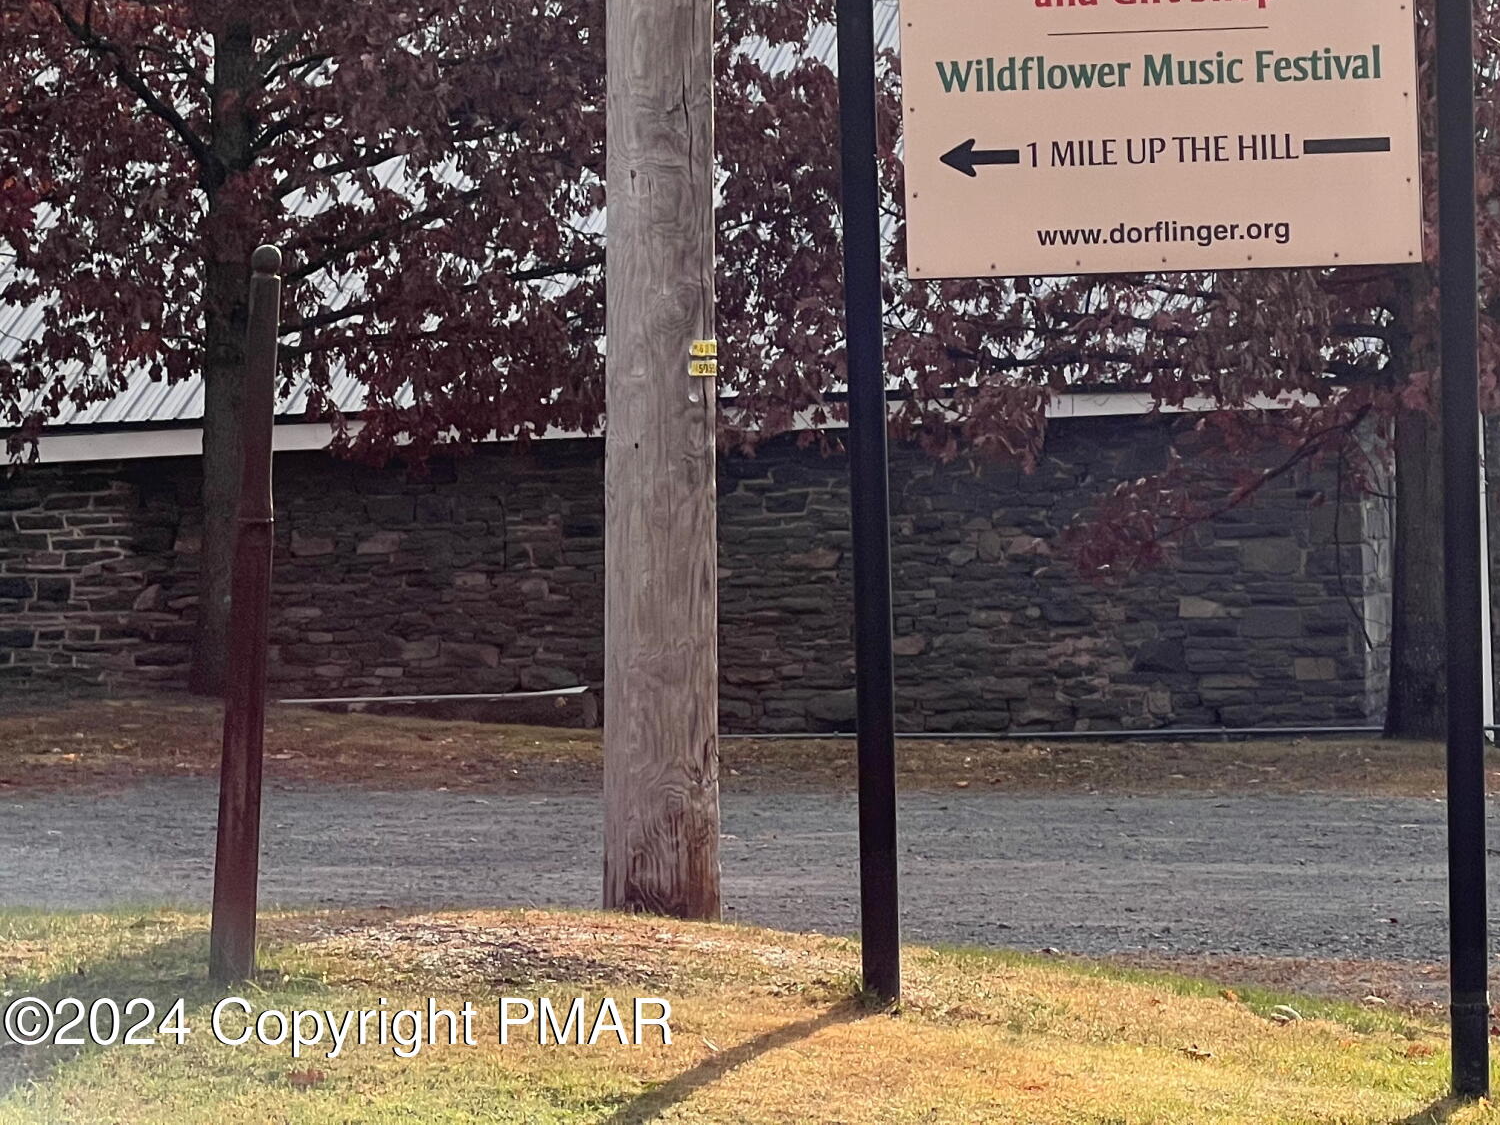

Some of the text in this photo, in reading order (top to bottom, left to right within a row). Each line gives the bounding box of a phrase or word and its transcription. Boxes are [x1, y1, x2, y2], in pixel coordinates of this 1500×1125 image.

[936, 45, 1380, 93] Wildflower Music Festival
[1027, 134, 1299, 167] 1 MILE UP THE HILL
[1037, 221, 1290, 246] www.dorflinger.org
